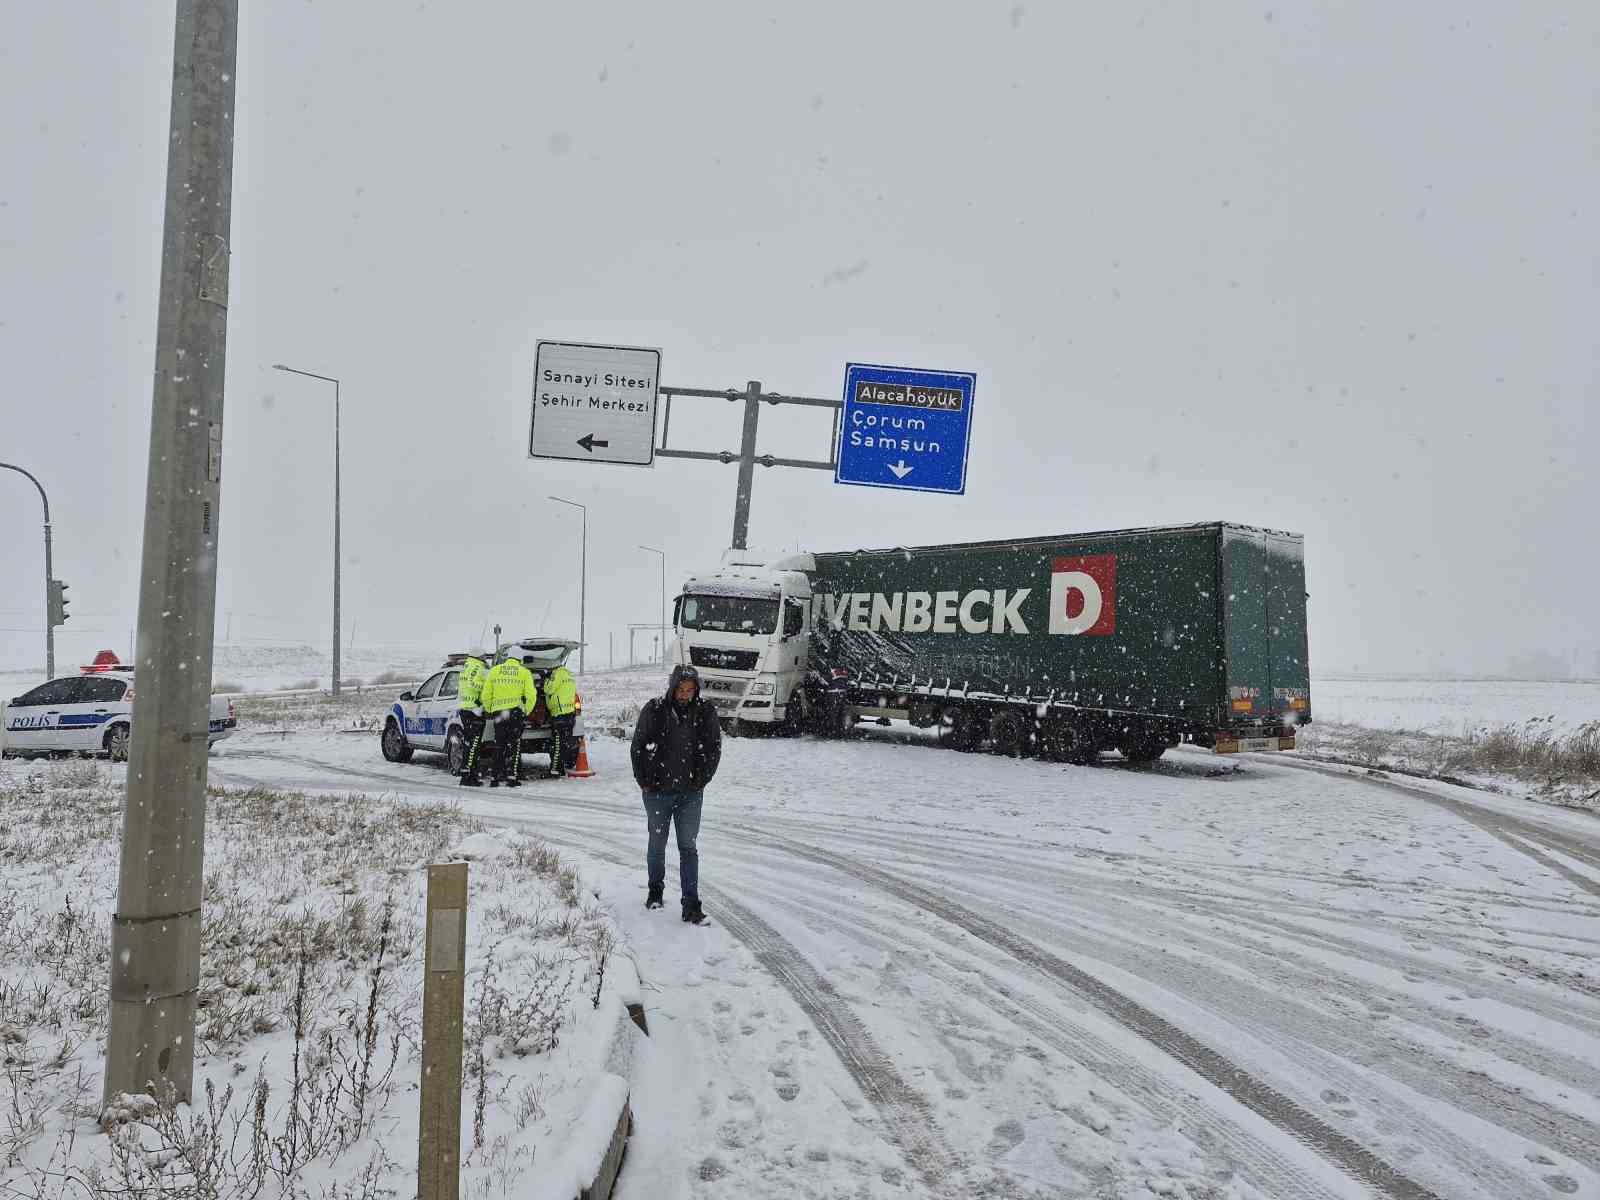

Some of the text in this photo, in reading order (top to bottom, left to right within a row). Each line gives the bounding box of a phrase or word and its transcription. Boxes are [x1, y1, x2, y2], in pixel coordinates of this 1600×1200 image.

[543, 369, 650, 389] Sanayi Sitesi
[541, 393, 649, 412] Şehir Merkezi
[860, 386, 958, 407] Alacahöyük
[852, 410, 925, 430] Çorum
[850, 431, 940, 453] Samsun
[1049, 571, 1103, 635] D
[710, 654, 737, 666] MAN
[704, 680, 732, 691] TGX
